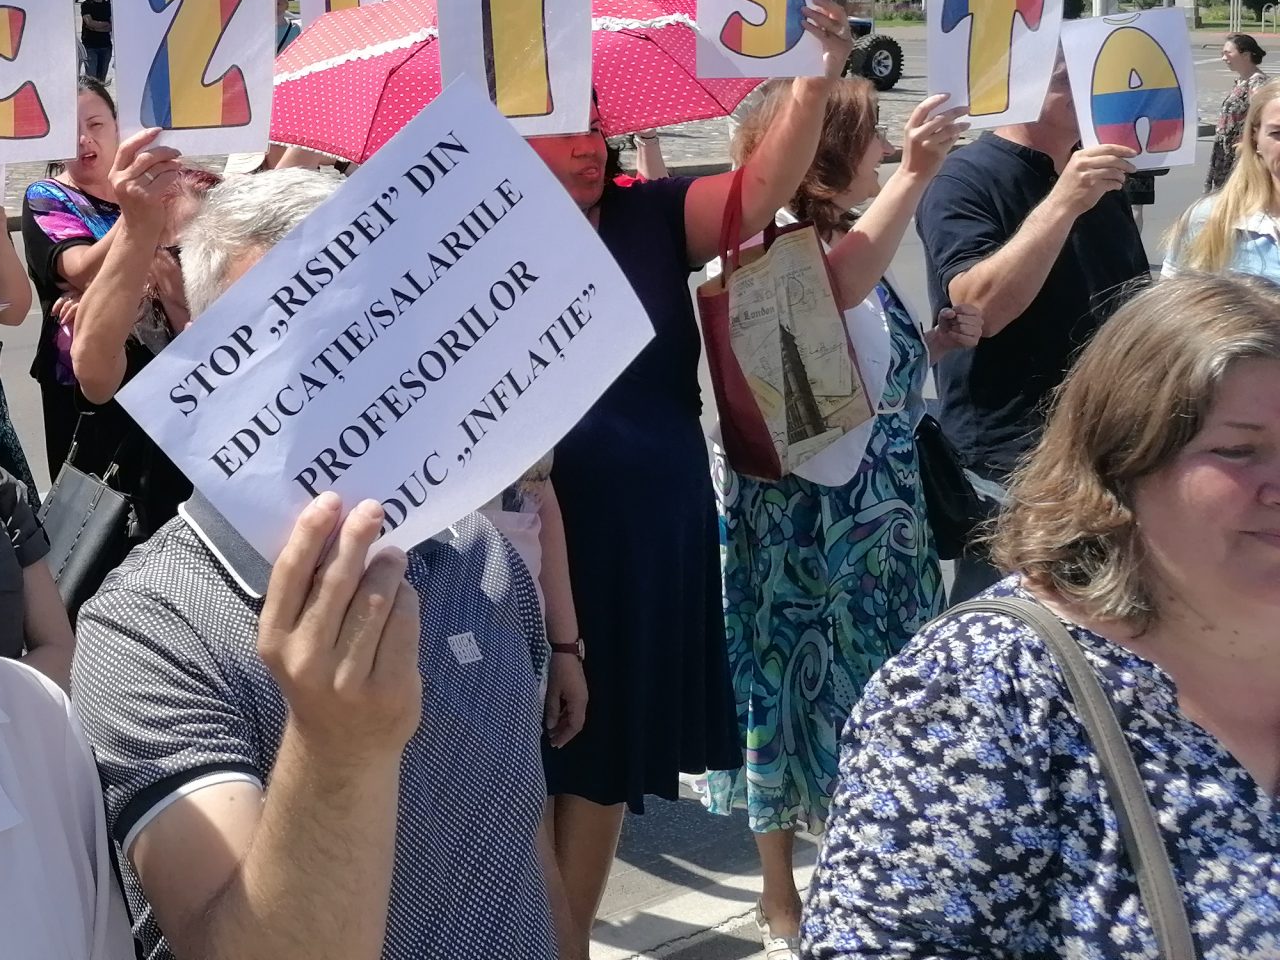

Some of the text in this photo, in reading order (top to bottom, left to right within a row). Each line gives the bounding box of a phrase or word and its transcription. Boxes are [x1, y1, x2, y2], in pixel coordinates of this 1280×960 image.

[1090, 12, 1185, 156] Ă
[169, 324, 259, 417] STOP
[401, 130, 470, 197] DIN
[207, 178, 524, 480] EDUCAȚIE/SALARIILE
[292, 260, 540, 500] PROFESORILOR
[376, 450, 449, 540] DUC
